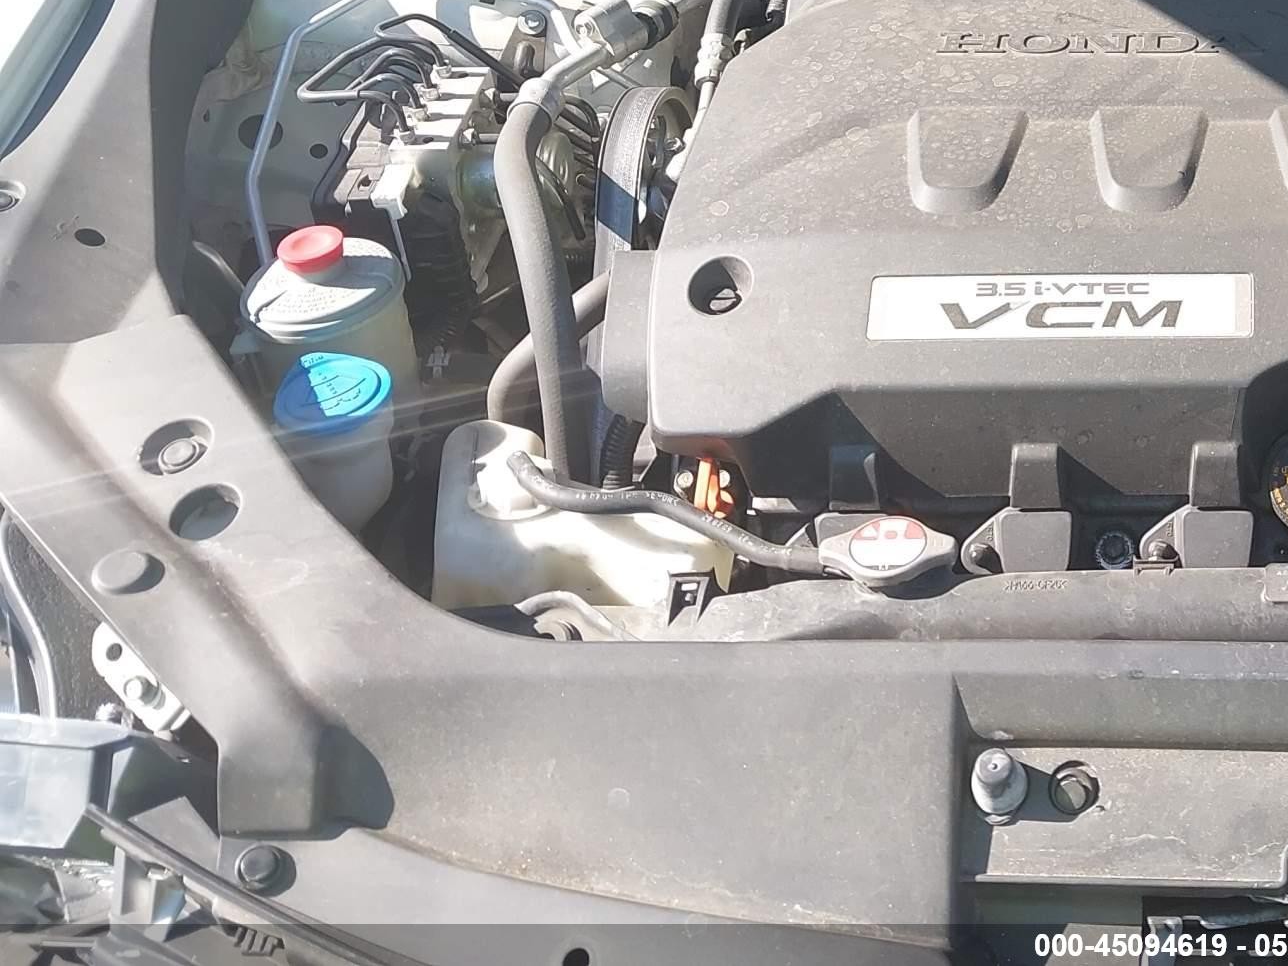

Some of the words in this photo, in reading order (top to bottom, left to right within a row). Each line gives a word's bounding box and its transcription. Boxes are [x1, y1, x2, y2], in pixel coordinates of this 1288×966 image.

[936, 31, 1265, 55] HONDA
[975, 282, 1027, 296] 3.5
[1034, 282, 1150, 296] i-VTEC
[940, 299, 1184, 330] VCM
